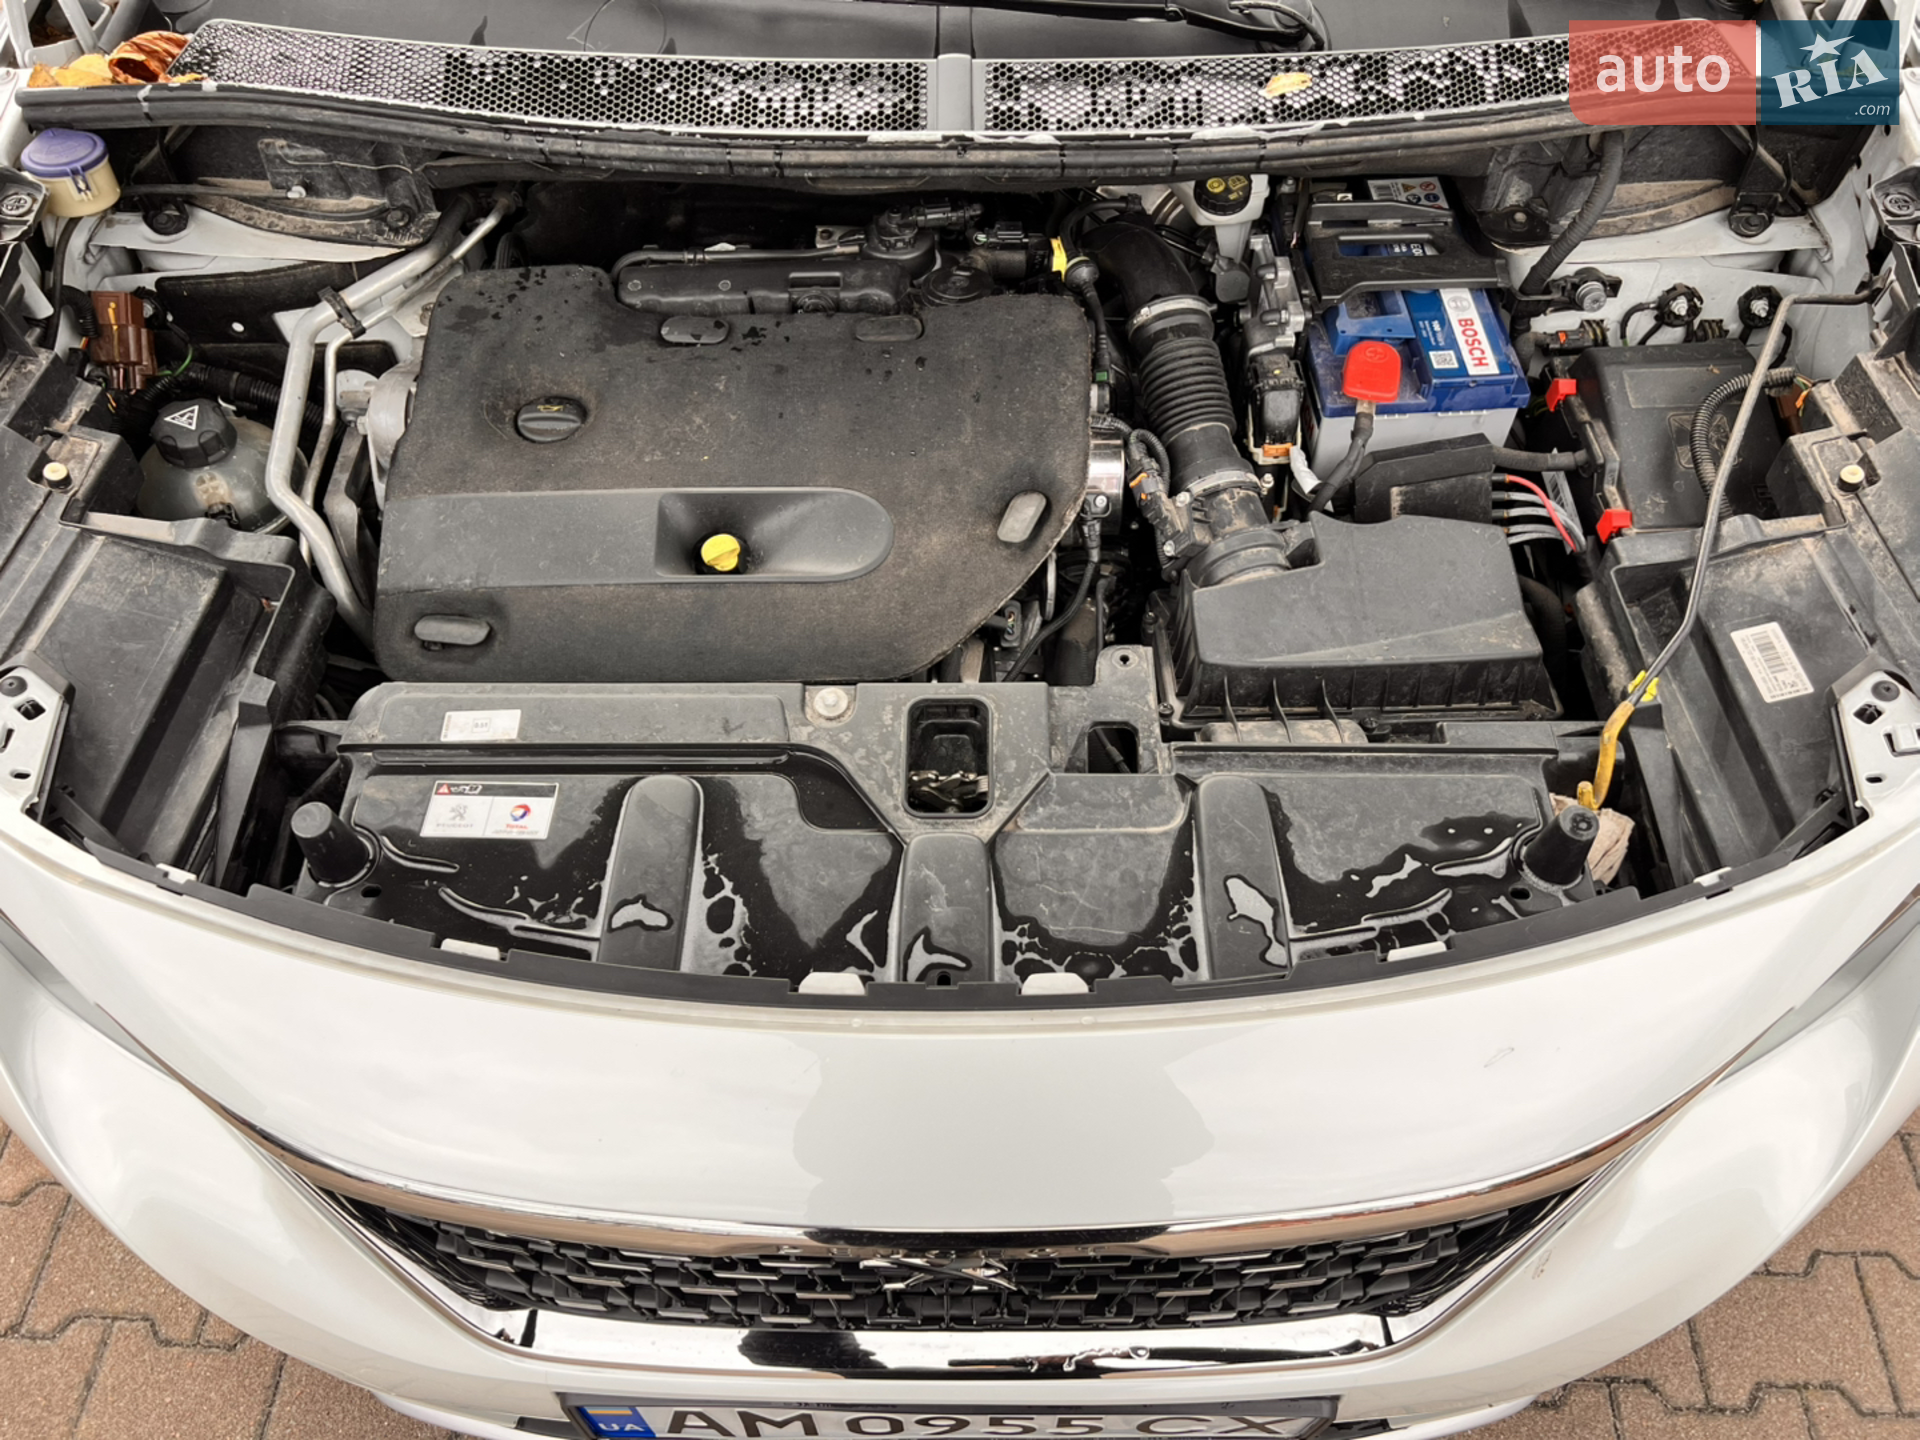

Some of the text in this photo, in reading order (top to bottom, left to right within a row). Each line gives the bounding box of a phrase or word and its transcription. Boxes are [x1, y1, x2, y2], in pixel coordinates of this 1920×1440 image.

[1457, 317, 1489, 368] BOSCH
[598, 1422, 645, 1432] UA
[667, 1410, 1300, 1438] AM 0955 CX
